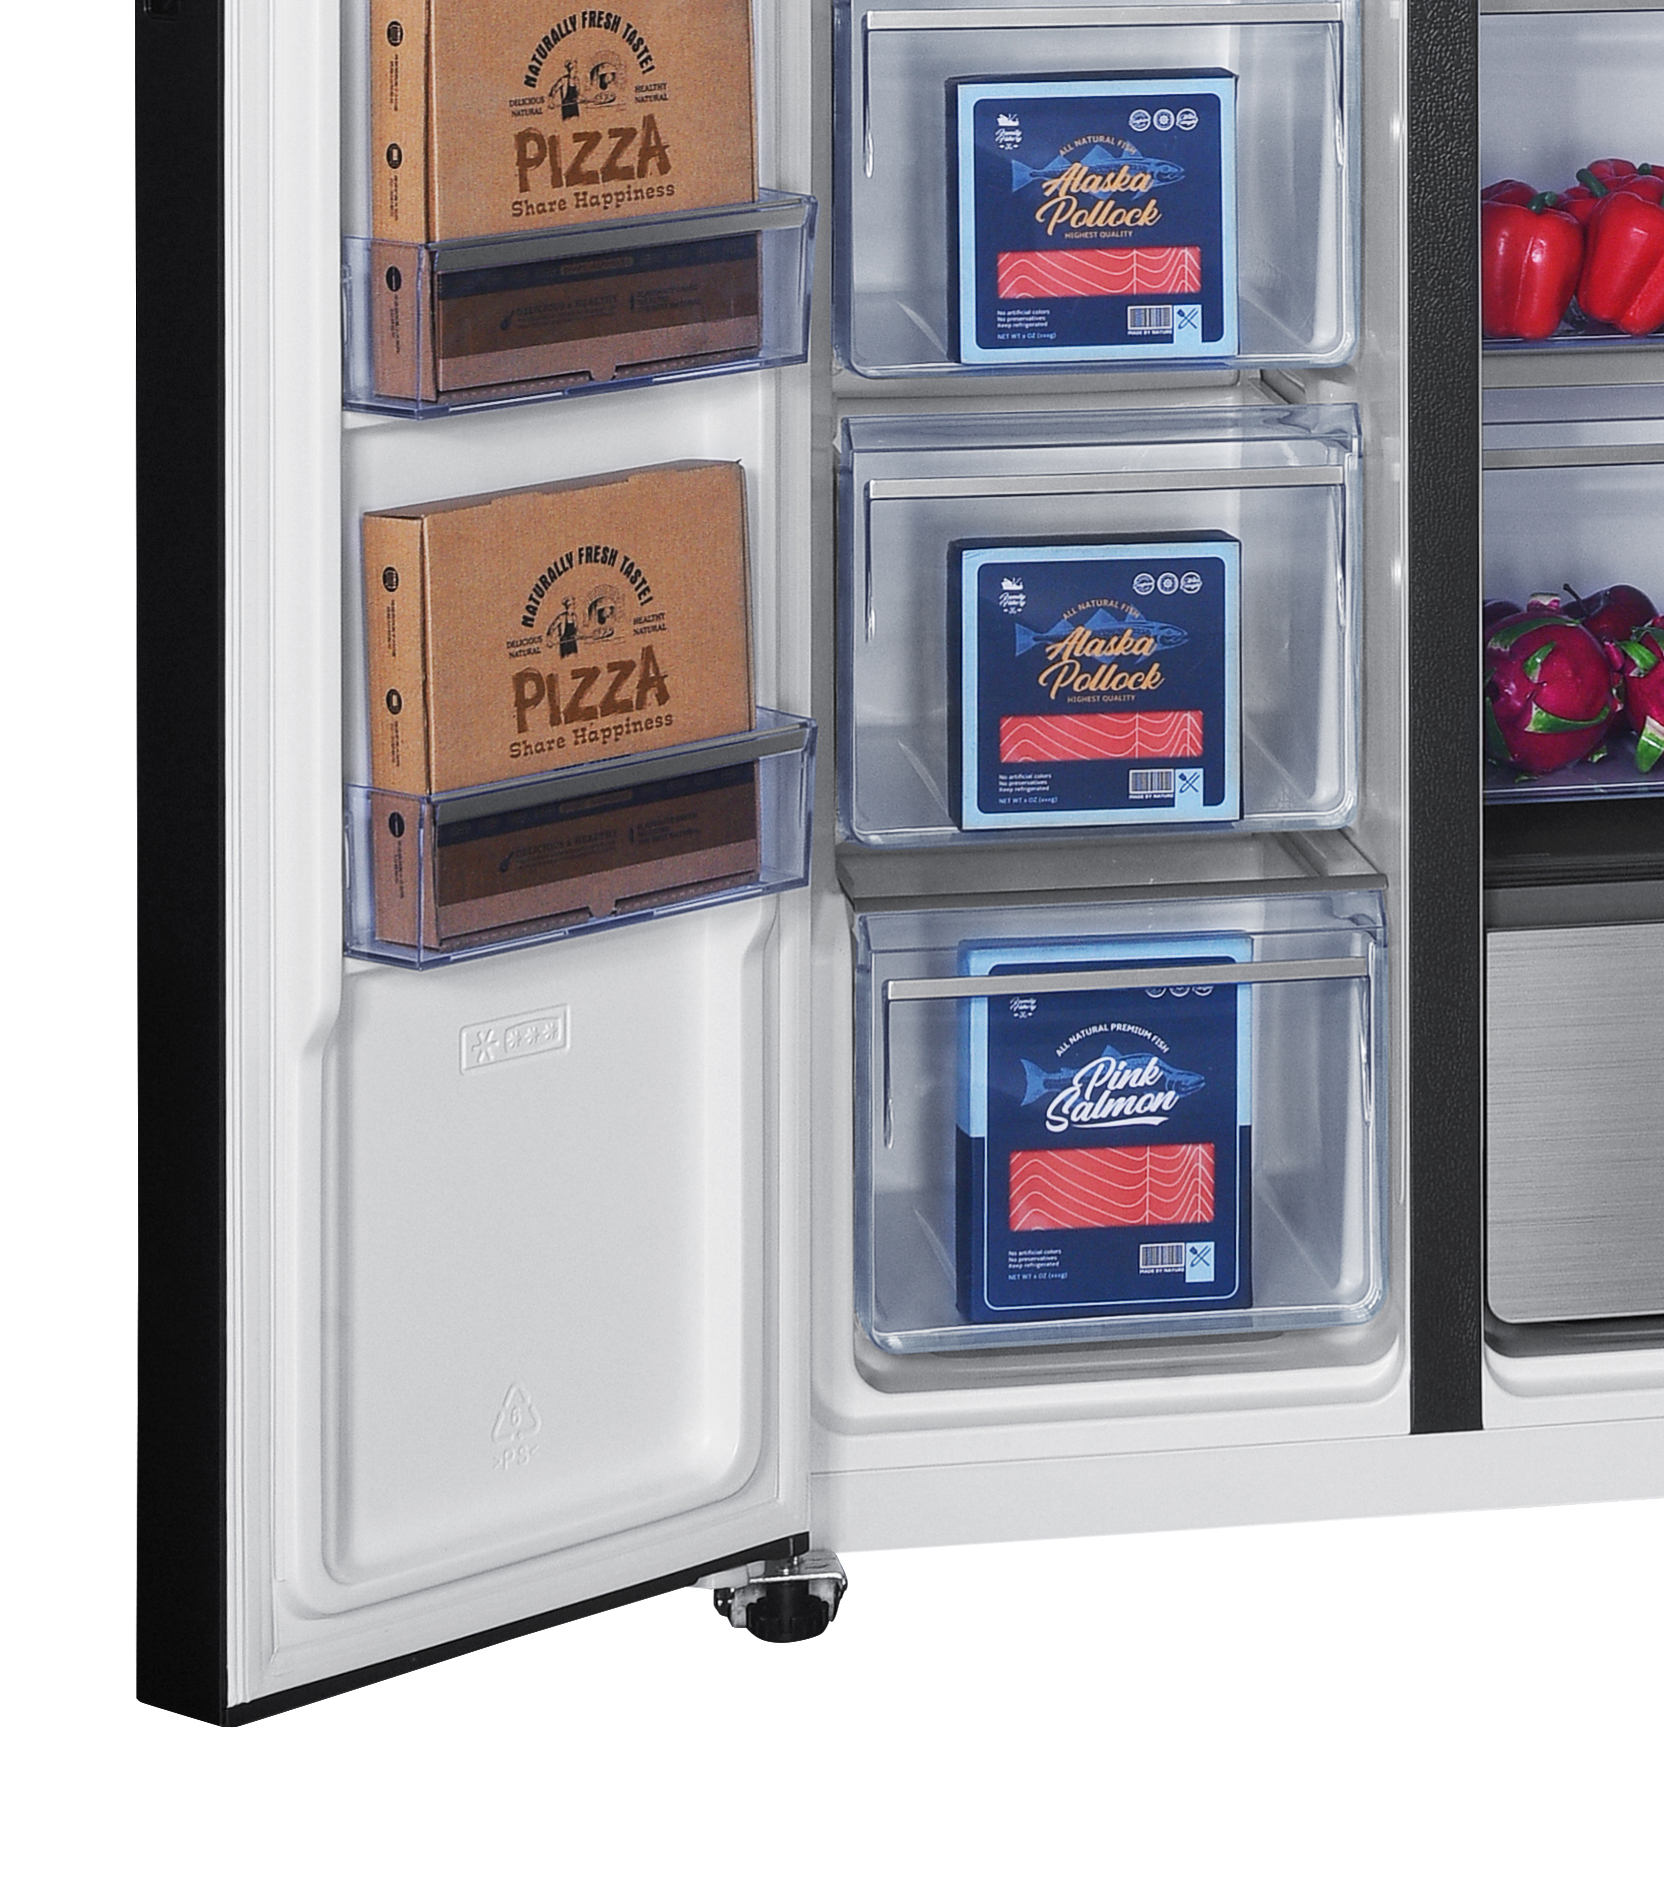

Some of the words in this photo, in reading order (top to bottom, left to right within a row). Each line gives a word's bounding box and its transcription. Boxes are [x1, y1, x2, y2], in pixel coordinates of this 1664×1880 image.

[523, 14, 578, 89] NATURALLY
[581, 10, 622, 34] FRESH
[622, 22, 656, 75] TASTE!
[508, 95, 545, 108] DELICIOUS
[634, 82, 668, 94] HEALTHY
[634, 93, 669, 104] NATURAL
[511, 106, 544, 117] NATURAL
[513, 113, 672, 194] PIZZA
[1058, 143, 1075, 157] ALL
[1074, 135, 1116, 148] NATURAL
[1116, 139, 1138, 155] FISH
[1041, 161, 1155, 198] Alaska
[511, 196, 567, 218] Share
[573, 183, 675, 211] Happiness
[1035, 195, 1163, 236] Pollock
[1064, 231, 1098, 239] HIGHEST
[1099, 230, 1133, 239] QUALITY
[521, 551, 574, 628] NATURALLY
[578, 545, 618, 567] FRESH
[619, 555, 654, 607] TASTE!
[633, 611, 666, 625] HEALTHY
[1062, 607, 1078, 620] ALL
[1078, 598, 1119, 611] NATURAL
[1120, 603, 1141, 619] FISH
[506, 634, 543, 649] DELICIOUS
[633, 623, 667, 636] NATURAL
[1045, 624, 1158, 661] Alaska
[508, 646, 542, 659] NATURAL
[512, 644, 671, 734] PIZZA
[1038, 659, 1165, 700] Pollock
[1101, 694, 1136, 702] QUALITY
[509, 737, 567, 759] Share
[572, 713, 674, 746] Happiness
[1055, 1041, 1071, 1058] ALL
[1069, 1023, 1110, 1045] NATURAL
[1110, 1023, 1151, 1041] PREMIUM
[1150, 1034, 1170, 1054] FISH
[1072, 1056, 1164, 1101] Pink
[1045, 1086, 1179, 1133] Salmon
[510, 1405, 522, 1427] 6
